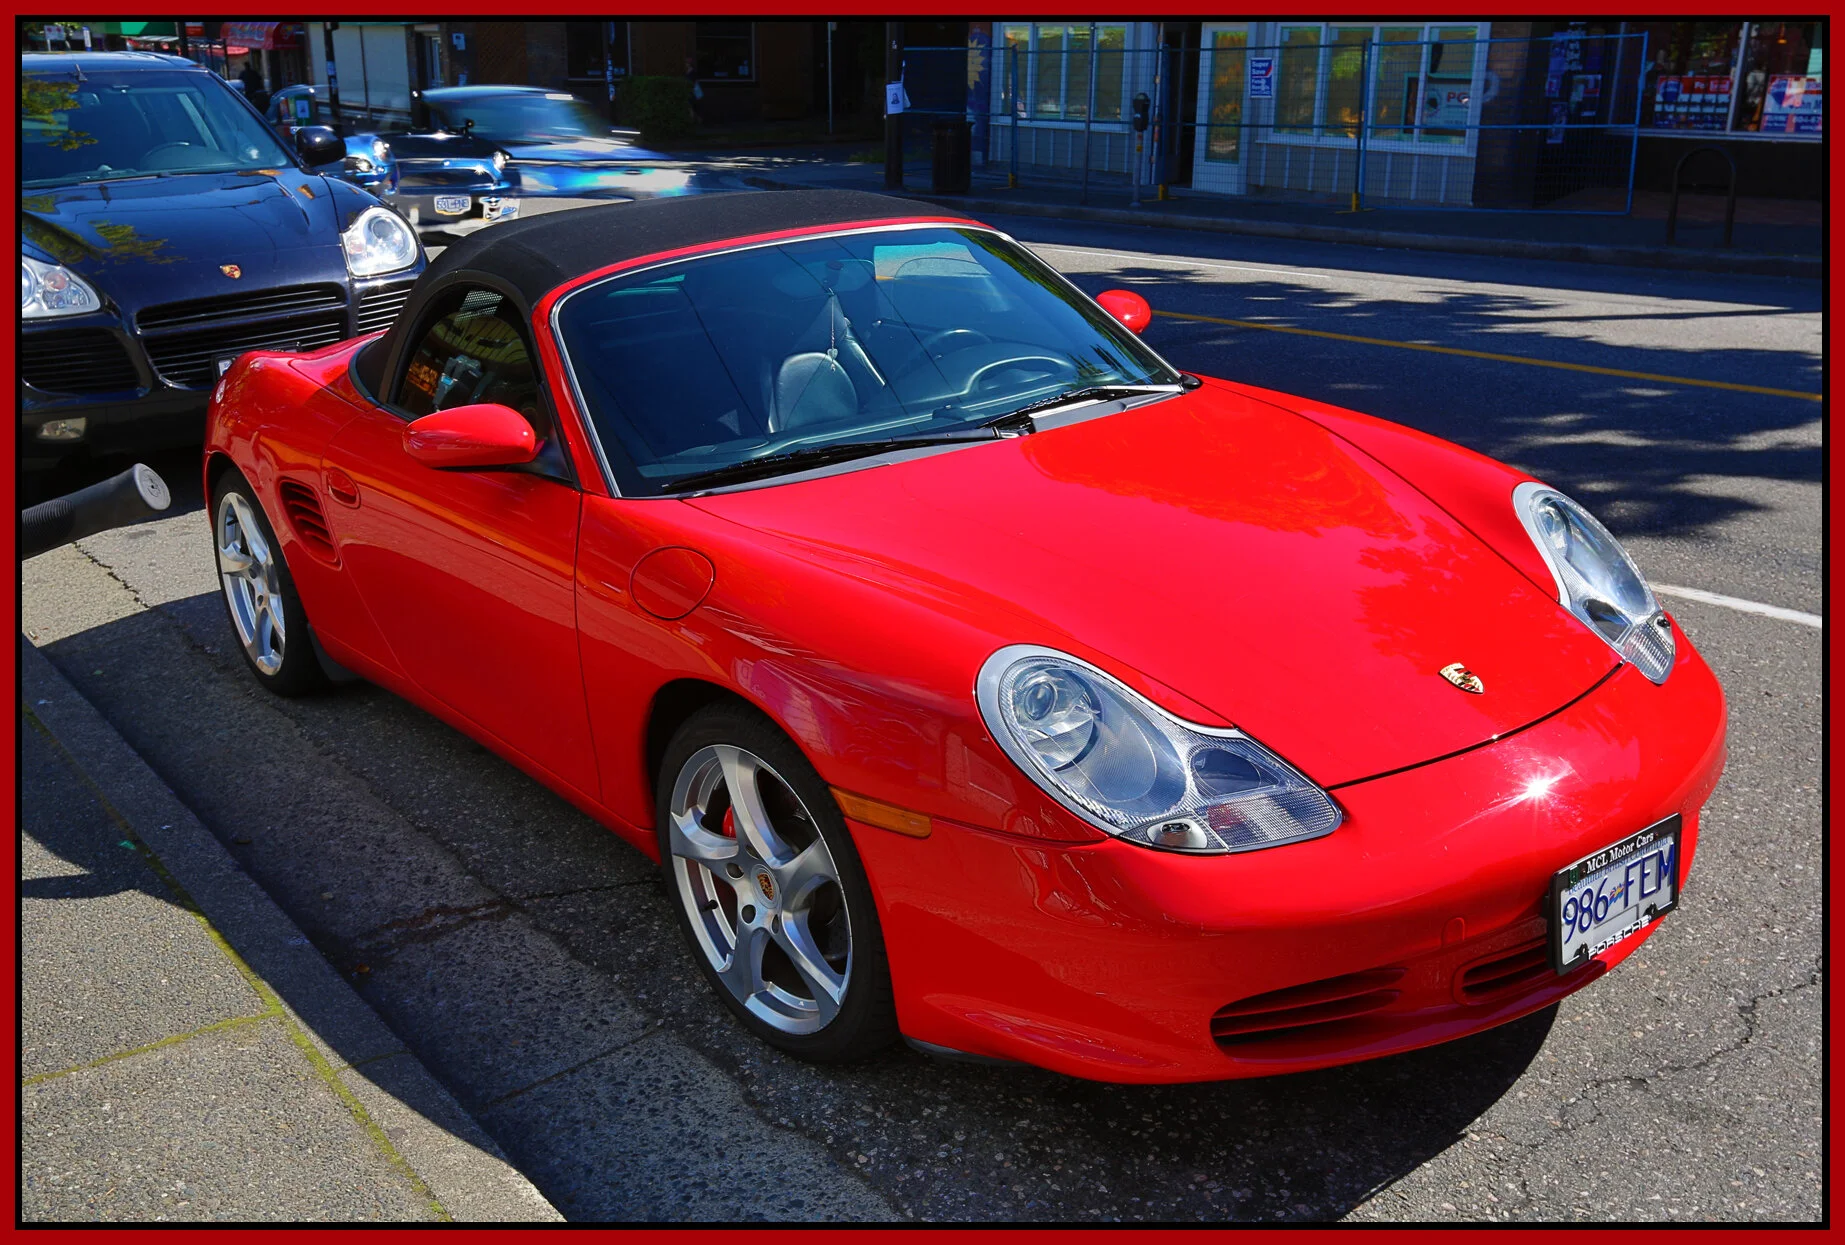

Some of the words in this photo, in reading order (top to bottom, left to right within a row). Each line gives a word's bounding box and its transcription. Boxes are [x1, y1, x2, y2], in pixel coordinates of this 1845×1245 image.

[1252, 61, 1269, 69] Super
[1587, 854, 1609, 874] MCL
[1609, 842, 1635, 862] Motor
[1636, 832, 1654, 849] Cars
[1563, 874, 1610, 945] 986
[1624, 842, 1675, 910] FEM
[1588, 913, 1653, 961] PORSCHE
